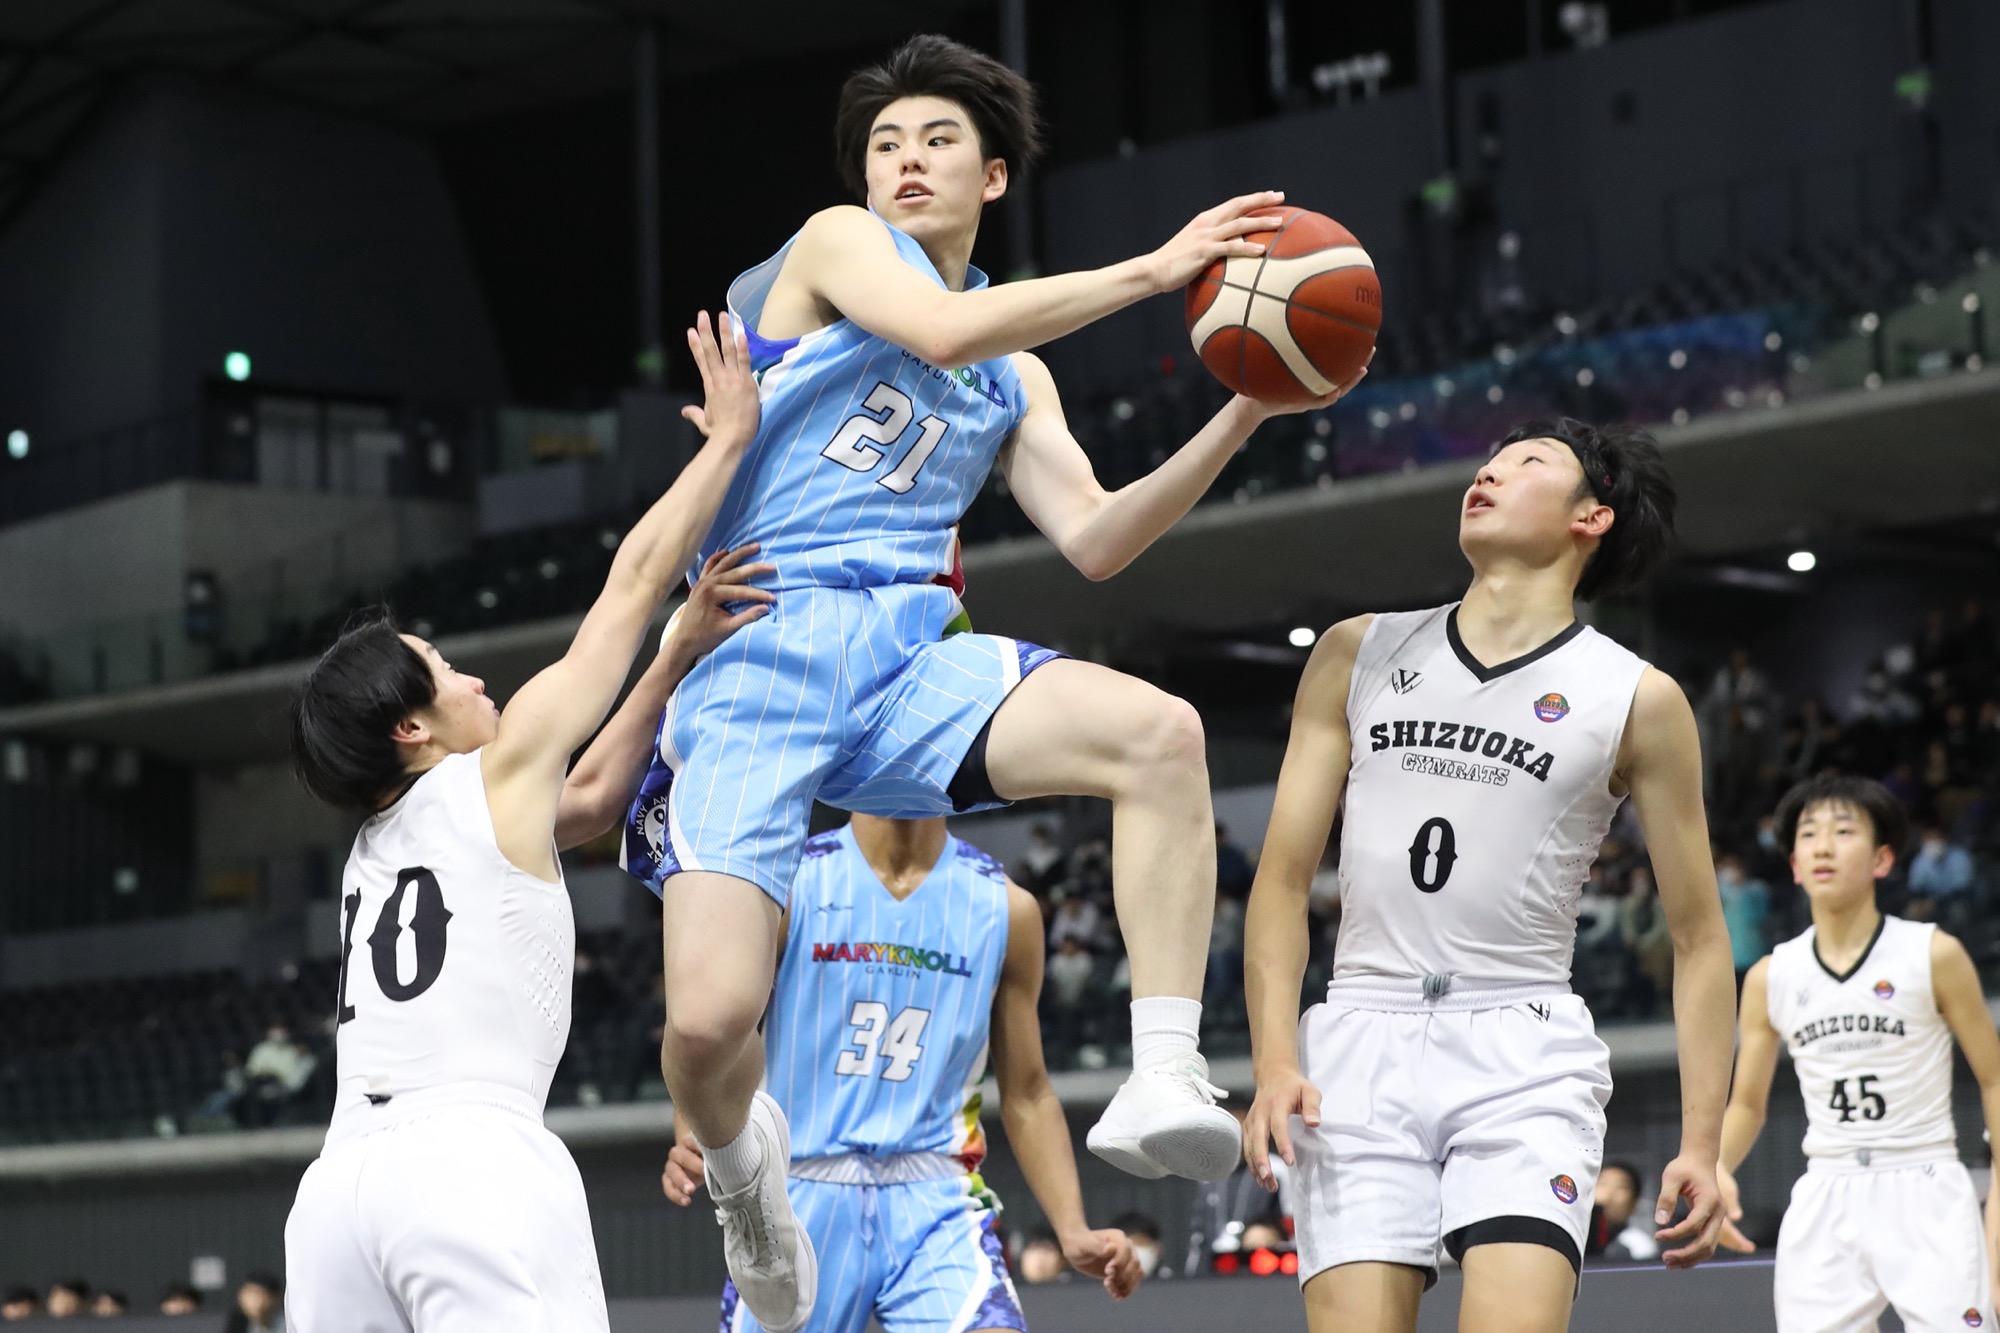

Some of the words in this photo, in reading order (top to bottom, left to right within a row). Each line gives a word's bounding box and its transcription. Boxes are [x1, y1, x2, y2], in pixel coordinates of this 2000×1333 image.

[901, 349, 957, 391] GAKUIN
[820, 380, 950, 495] 21
[1369, 720, 1555, 782] SHIZUOKA
[1401, 752, 1510, 786] GYMRATS
[636, 805, 647, 835] NAVY
[1408, 816, 1458, 894] 0
[338, 866, 454, 1024] 10
[812, 942, 973, 978] MARYKNOLL
[865, 965, 921, 980] GAKUIN
[834, 1000, 932, 1082] 34
[1793, 1014, 1906, 1047] SHIZUOKA
[1829, 1074, 1887, 1122] 45
